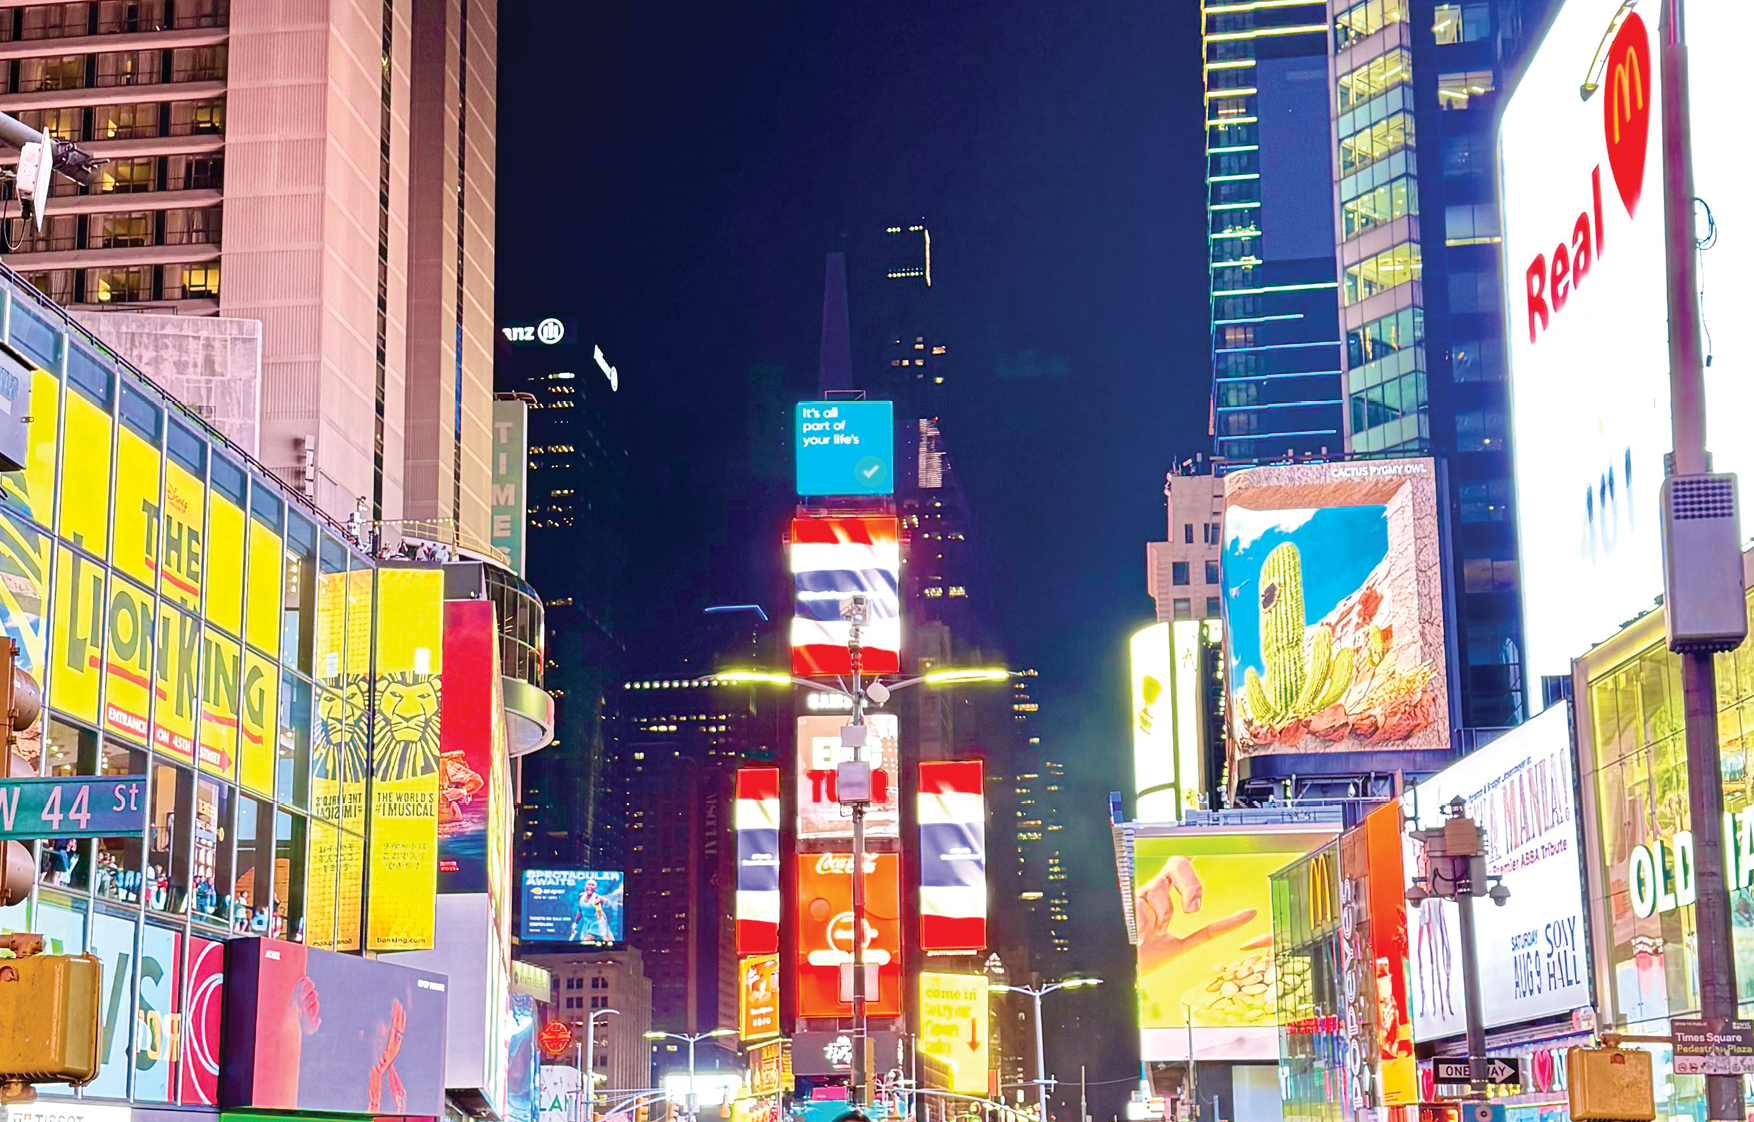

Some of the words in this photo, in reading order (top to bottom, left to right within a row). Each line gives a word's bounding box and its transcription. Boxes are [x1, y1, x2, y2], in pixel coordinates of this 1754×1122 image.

[1525, 163, 1604, 345] Real
[802, 407, 821, 418] It's
[823, 407, 838, 418] all
[802, 421, 830, 433] part
[833, 419, 846, 431] of
[802, 436, 831, 447] your
[833, 434, 859, 445] life's
[1331, 466, 1368, 478] CACTUS
[1369, 465, 1404, 476] PYGMY
[1404, 463, 1427, 474] OWL
[142, 498, 200, 584] THE
[67, 531, 170, 682] LION
[175, 596, 265, 729] KING
[108, 706, 148, 734] ENTRANCE
[157, 728, 170, 743] ON
[172, 735, 191, 753] 45TH
[199, 745, 221, 765] STREET
[377, 792, 393, 803] THE
[396, 792, 434, 803] WORLD'S
[41, 785, 91, 830] 44
[113, 783, 139, 812] St
[387, 803, 435, 817] MUSICAL
[1520, 848, 1540, 866] ABBA
[1541, 838, 1568, 860] Tribute
[525, 869, 620, 881] SPECTACULAR
[1629, 830, 1696, 919] OLD
[526, 878, 576, 886] AWAITS
[376, 937, 426, 945] lionking.com
[1511, 929, 1538, 952] SATURDAY
[1514, 951, 1534, 1000] AUG
[1534, 950, 1542, 994] 9
[1547, 950, 1581, 991] HALL
[925, 988, 962, 999] come
[964, 987, 977, 1000] in
[1675, 1032, 1705, 1042] Times
[1706, 1032, 1742, 1043] Square
[1727, 1044, 1753, 1053] Plaza
[1446, 1066, 1470, 1076] ONE
